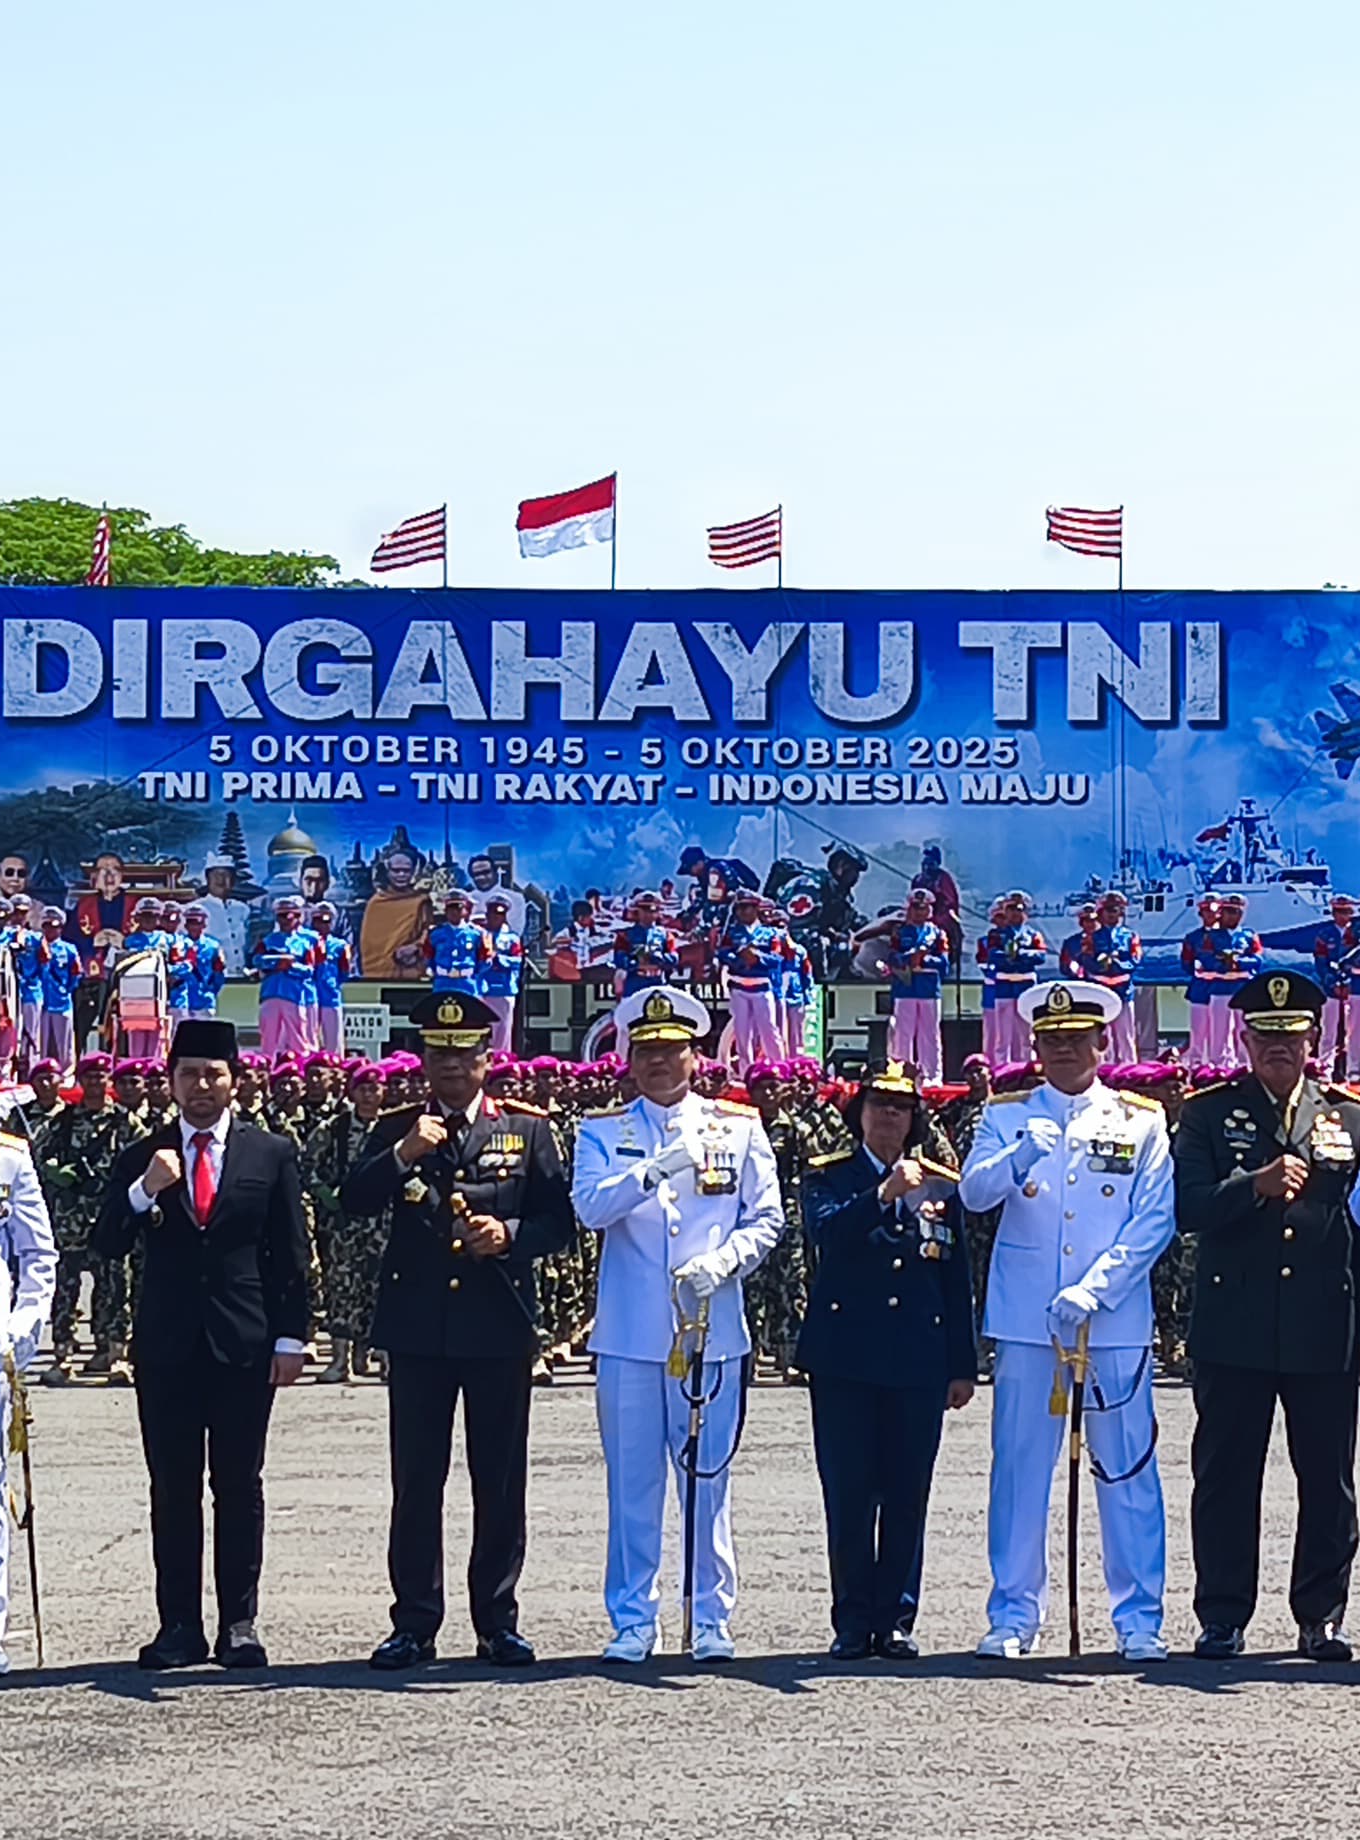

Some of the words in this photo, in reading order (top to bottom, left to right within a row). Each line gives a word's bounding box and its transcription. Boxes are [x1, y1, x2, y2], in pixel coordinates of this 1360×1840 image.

[3, 619, 914, 721] DIRGAHAYU
[959, 621, 1220, 721] TNI
[209, 735, 231, 762] 5
[252, 735, 458, 763] OKTOBER
[480, 737, 583, 764] 1945
[641, 738, 661, 764] 5
[682, 737, 888, 765] OKTOBER
[907, 737, 1016, 764] 2025
[137, 771, 206, 799] TNI
[222, 772, 362, 799] PRIMA
[410, 773, 478, 800] TNI
[495, 773, 662, 801] RAKYAT
[709, 774, 944, 801] INDONESIA
[960, 774, 1089, 801] MAJU
